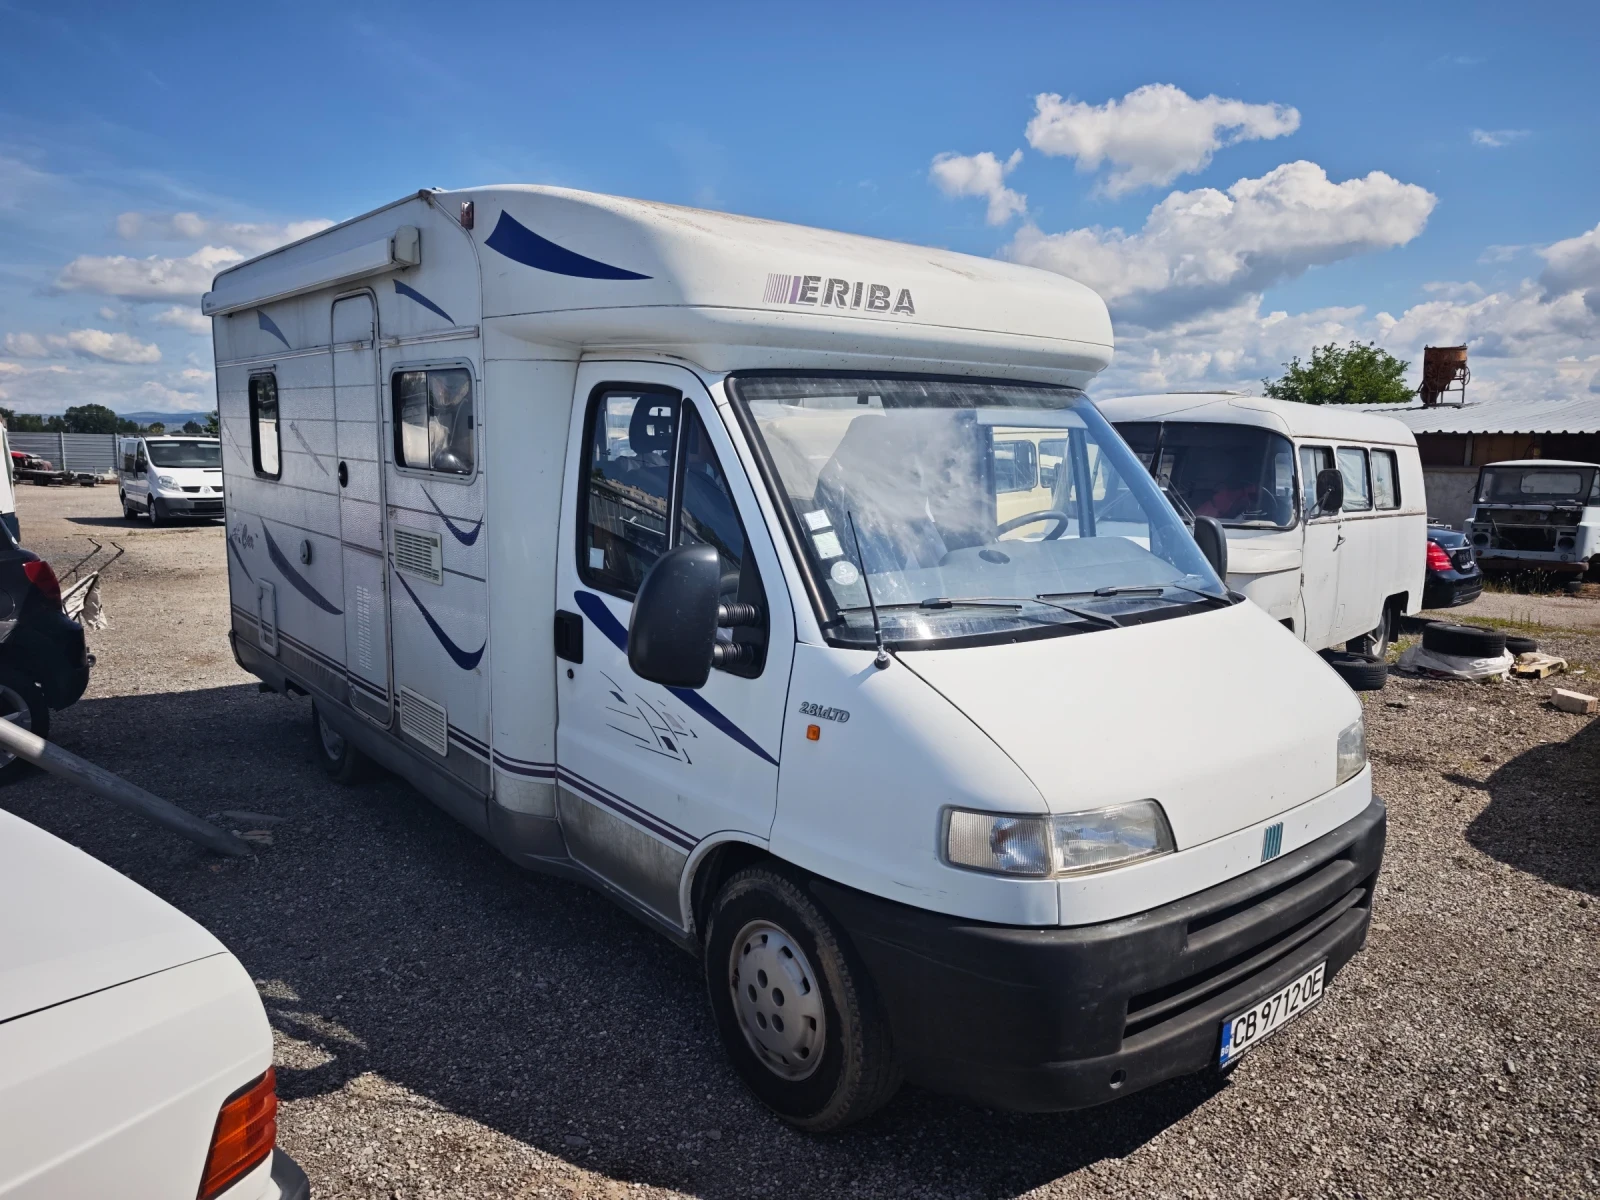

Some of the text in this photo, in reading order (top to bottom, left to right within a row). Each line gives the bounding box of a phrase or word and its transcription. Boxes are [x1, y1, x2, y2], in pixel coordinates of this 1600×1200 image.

[797, 275, 916, 316] ERIBA
[1233, 1010, 1257, 1048] CB
[1261, 982, 1301, 1031] 9712
[1220, 1045, 1230, 1057] BG
